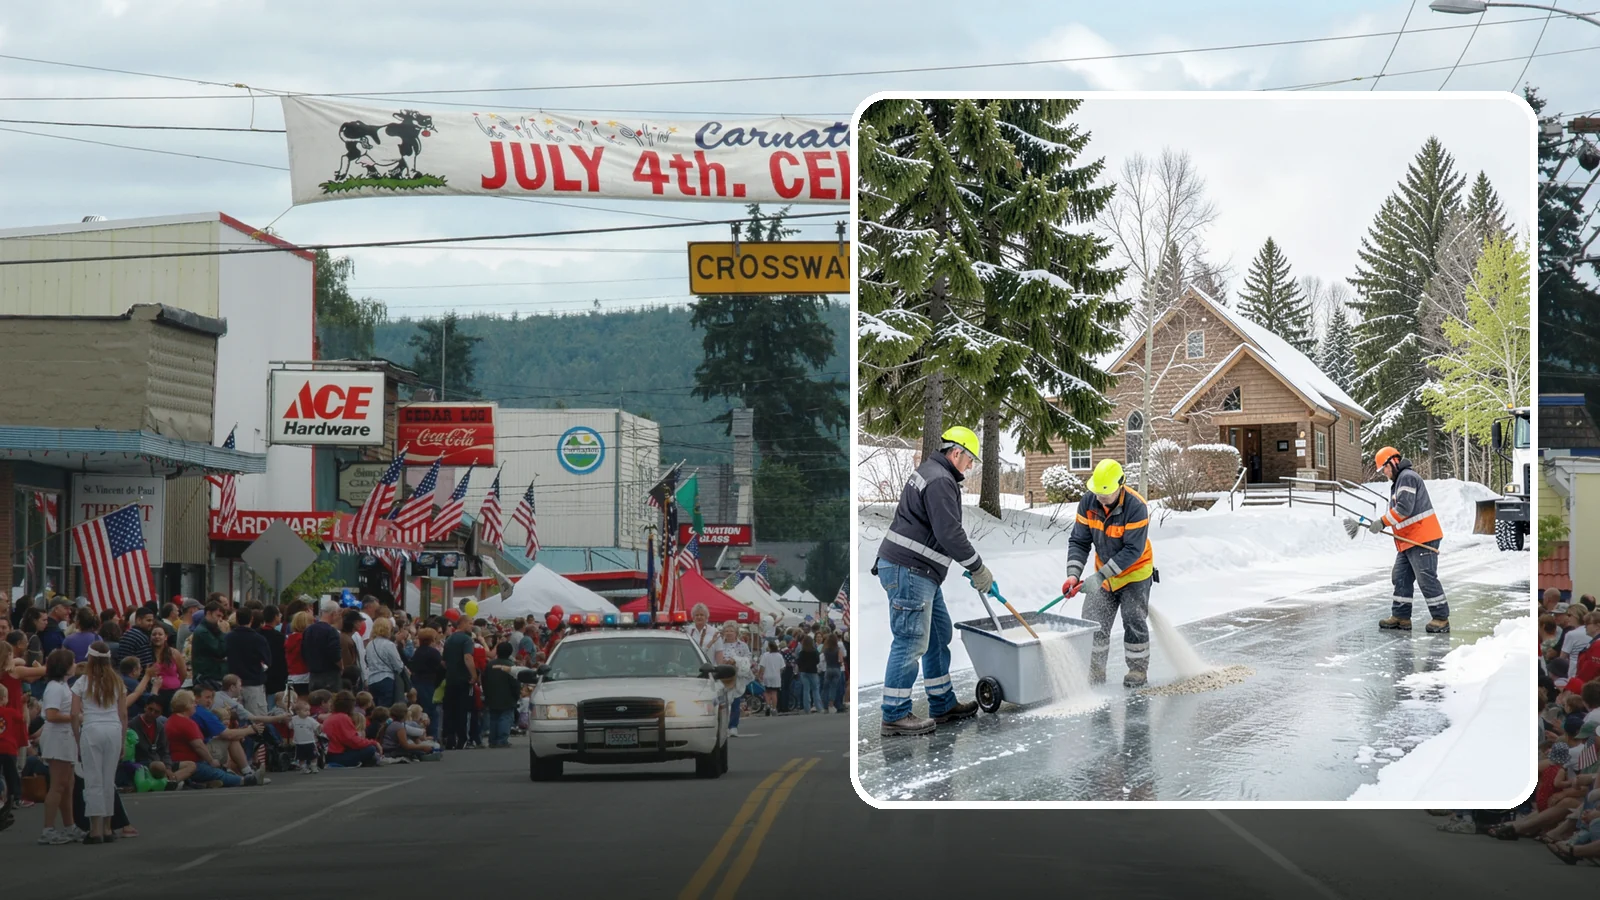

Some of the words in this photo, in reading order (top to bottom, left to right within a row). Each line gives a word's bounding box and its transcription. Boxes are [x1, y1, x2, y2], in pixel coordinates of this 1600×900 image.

[695, 121, 850, 149] Carnat
[481, 141, 605, 192] JULY
[632, 150, 746, 197] 4th.
[697, 254, 850, 280] CROSSWA
[282, 380, 373, 420] ACE
[406, 409, 452, 422] CEDAR
[461, 410, 485, 422] LOG
[283, 421, 371, 436] Hardware
[416, 428, 476, 447] Coca-Cola
[354, 467, 385, 478] Simpl
[95, 485, 124, 494] Vincent
[126, 486, 135, 494] de
[137, 486, 155, 495] Paul
[81, 503, 154, 521] THT
[213, 516, 330, 535] HARDARE
[688, 526, 741, 535] CRNATION
[699, 535, 730, 543] GLASS
